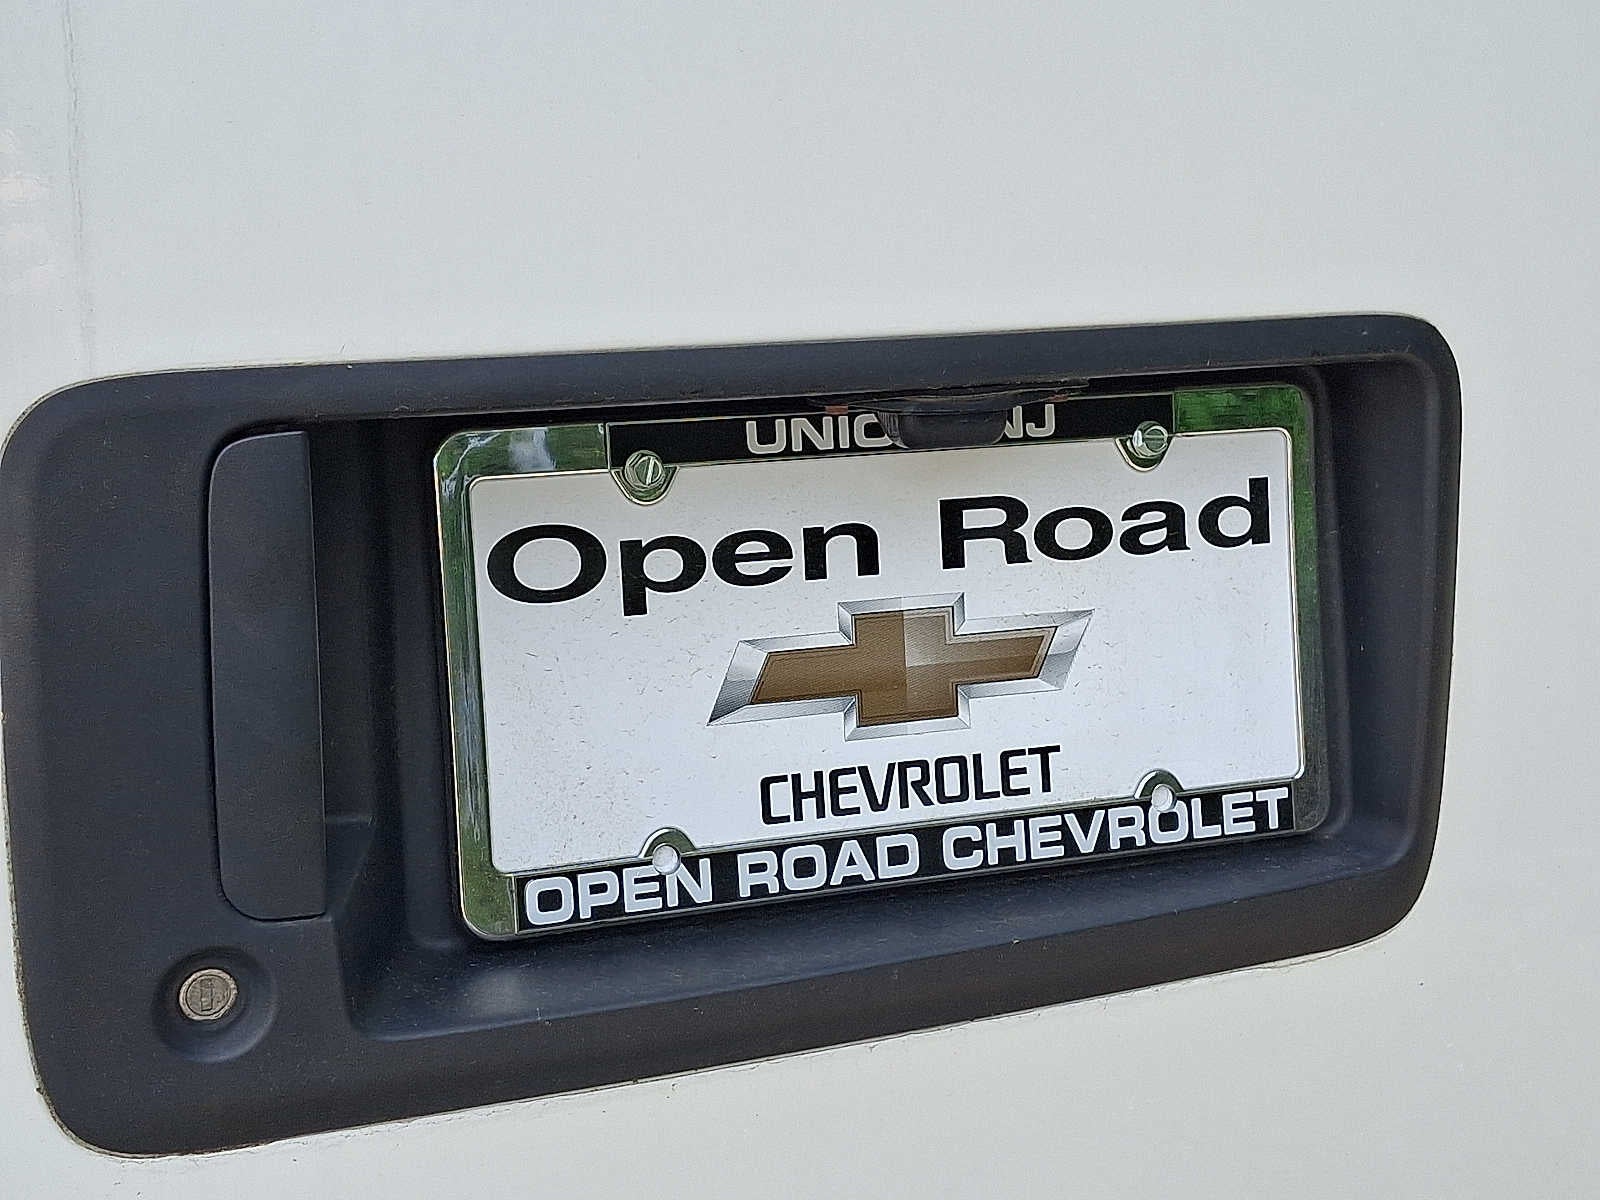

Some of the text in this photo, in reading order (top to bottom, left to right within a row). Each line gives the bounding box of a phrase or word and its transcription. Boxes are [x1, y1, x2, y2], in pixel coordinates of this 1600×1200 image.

[487, 476, 1271, 616] Open Road
[760, 745, 1061, 825] CHEVROLET
[525, 786, 1289, 926] OPEN ROAD CHEVROLET
